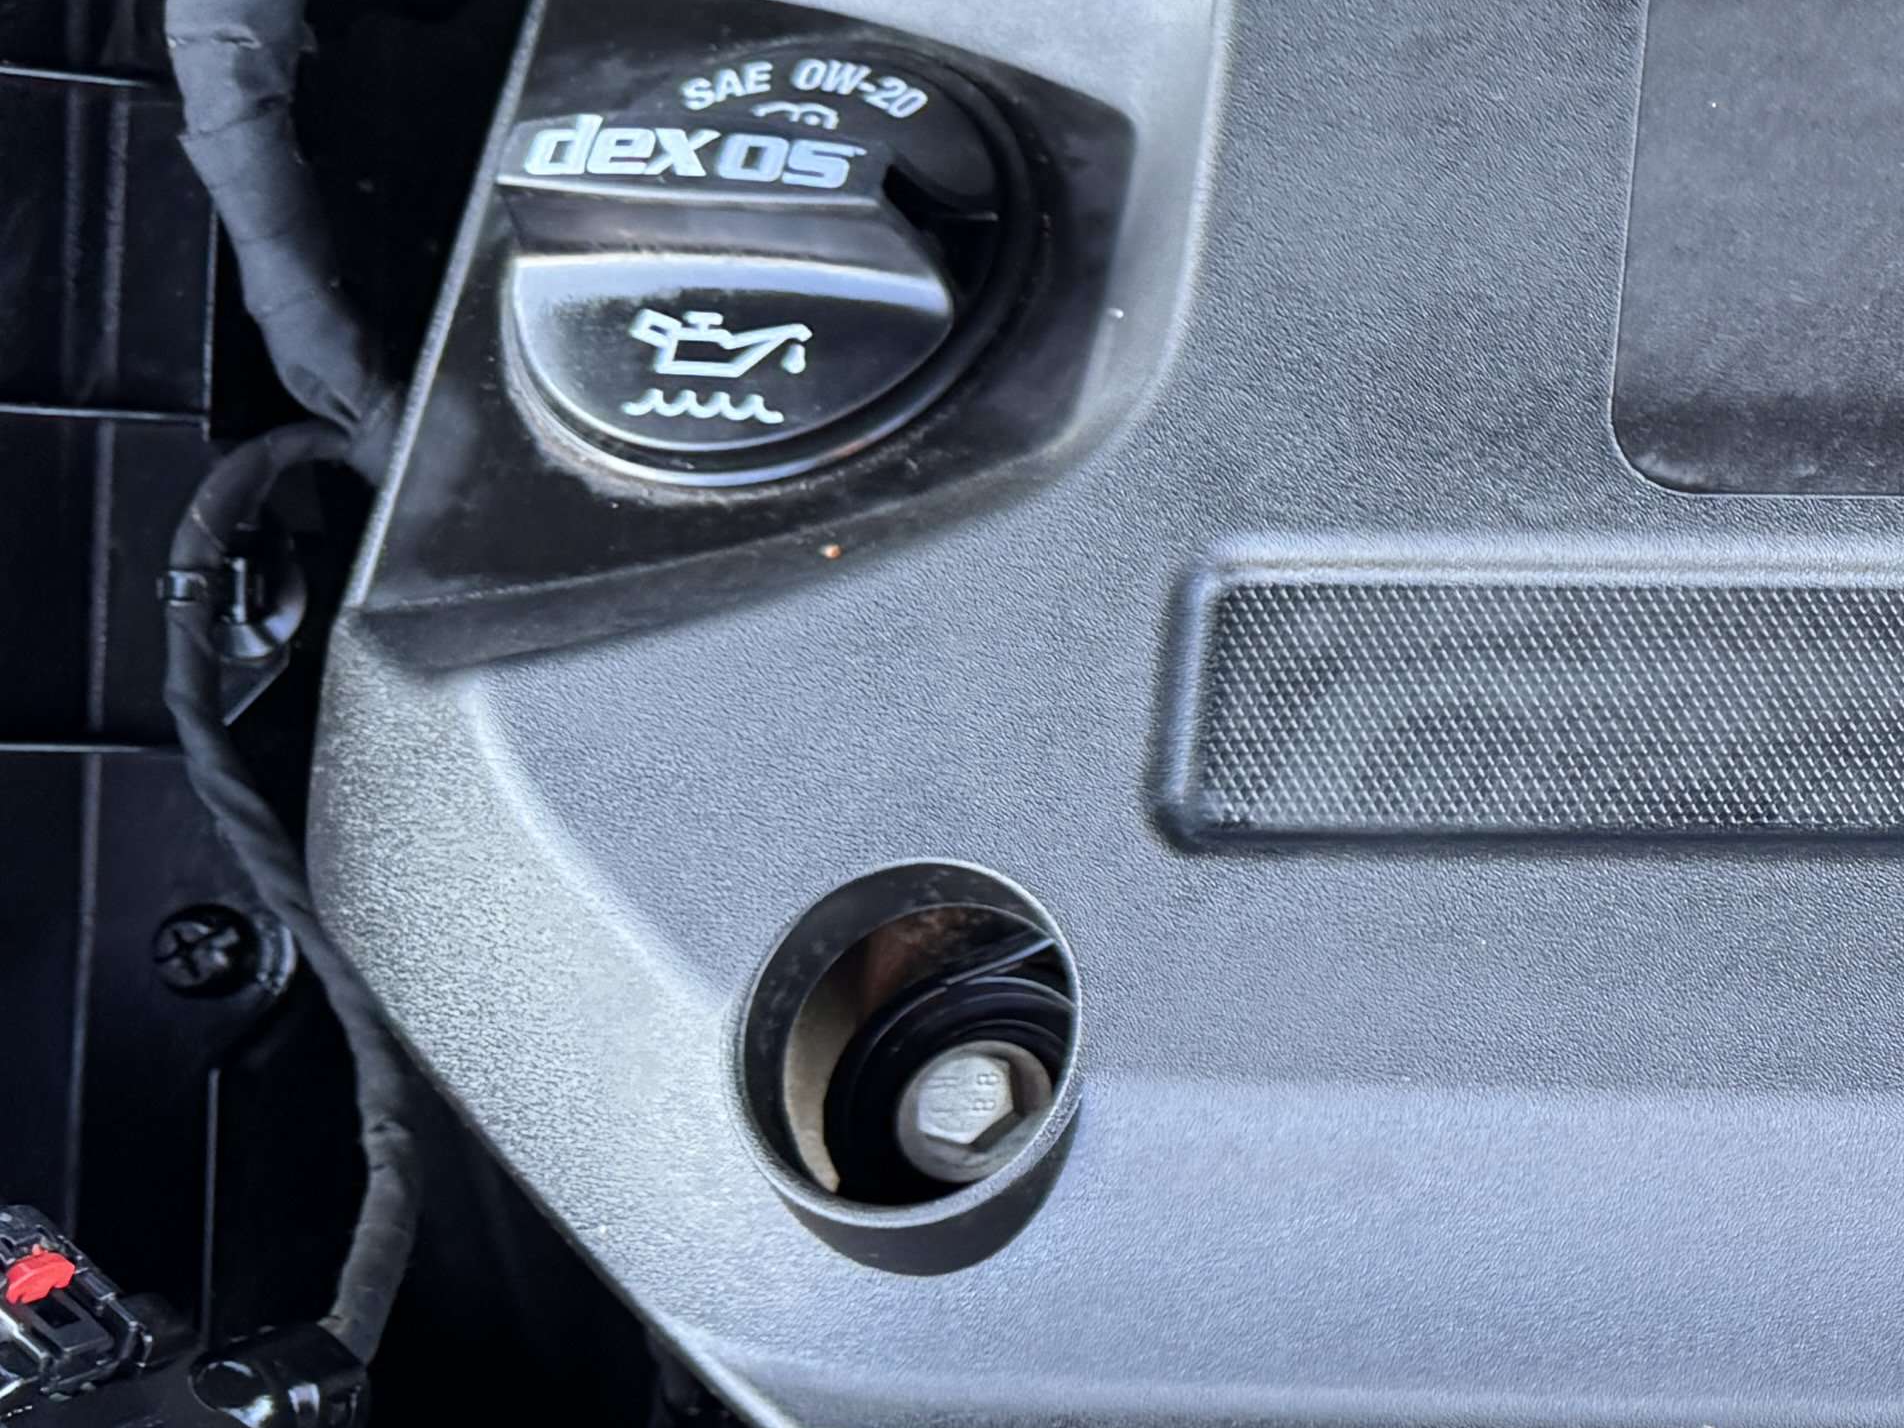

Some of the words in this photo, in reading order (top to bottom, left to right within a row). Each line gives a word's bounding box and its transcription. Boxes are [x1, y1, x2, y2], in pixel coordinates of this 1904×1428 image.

[679, 60, 774, 111] SAE
[789, 58, 928, 119] 0W-20
[524, 114, 867, 189] dexos
